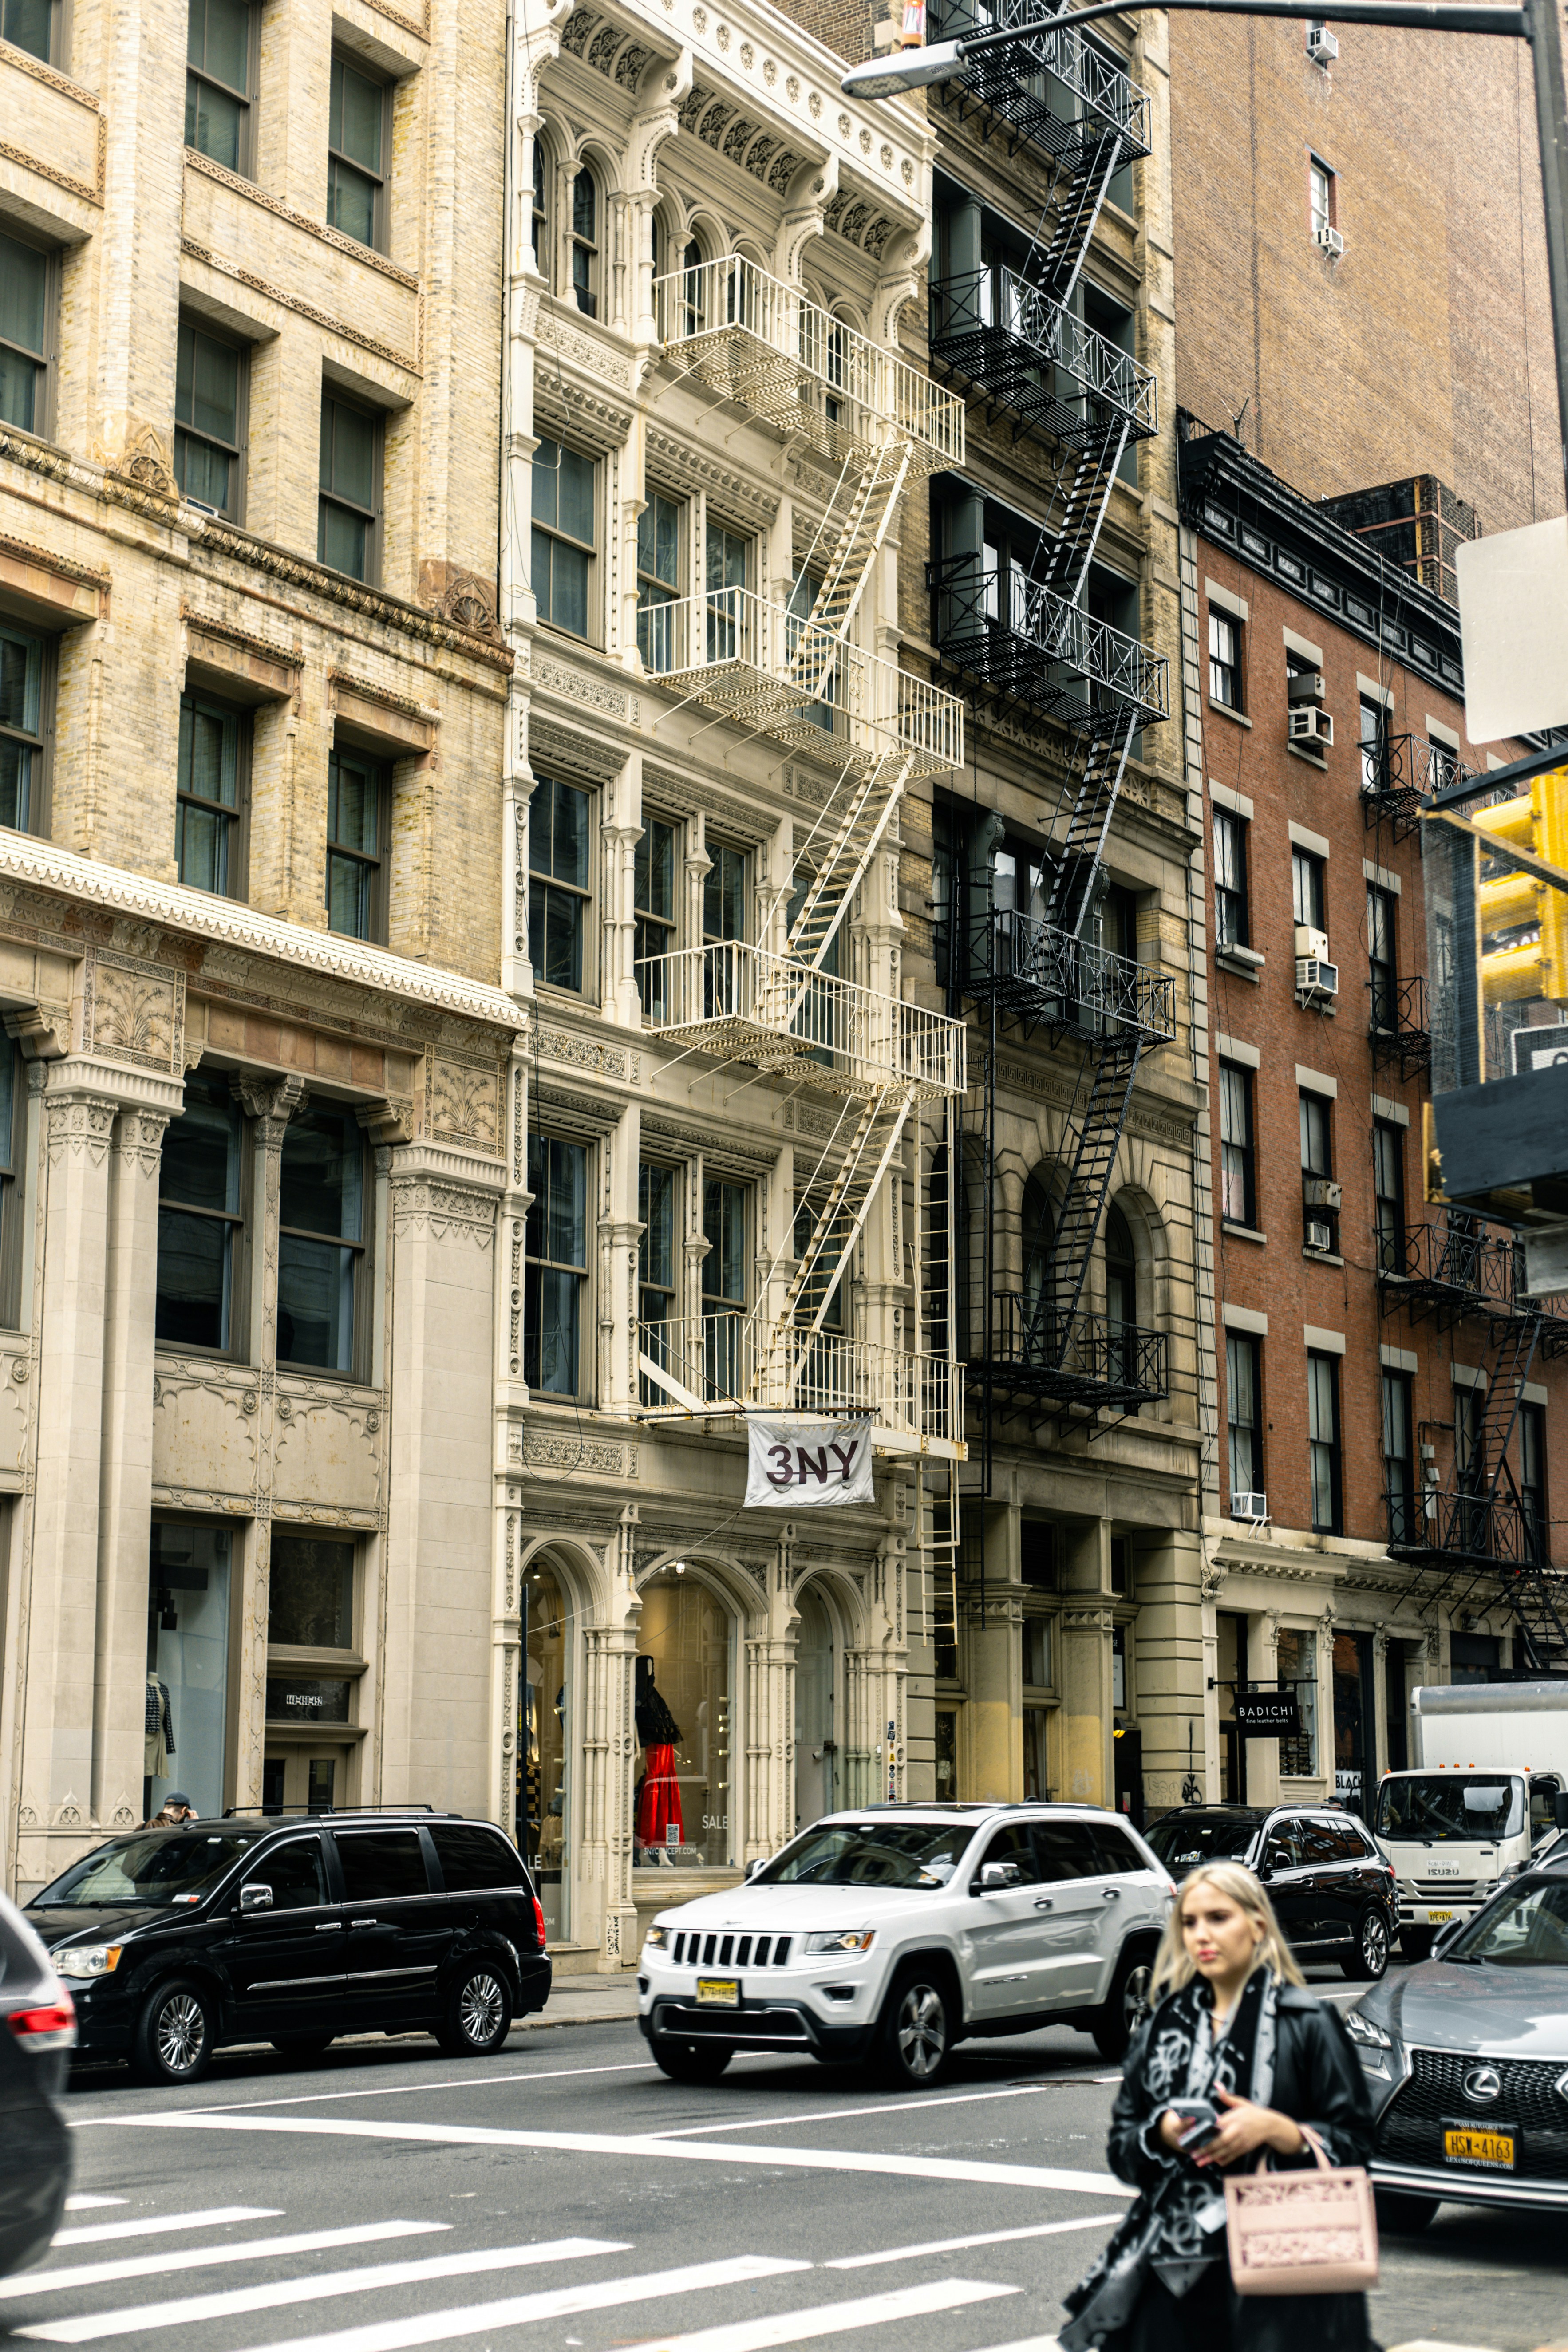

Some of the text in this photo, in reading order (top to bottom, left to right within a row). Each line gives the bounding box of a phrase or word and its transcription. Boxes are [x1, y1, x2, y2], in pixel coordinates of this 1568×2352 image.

[766, 1440, 859, 1484] 3NY
[1239, 1706, 1293, 1716] BADICHI
[702, 1815, 728, 1830] SALE
[1446, 2156, 1513, 2170] LEXUSOFQUEENS.COM
